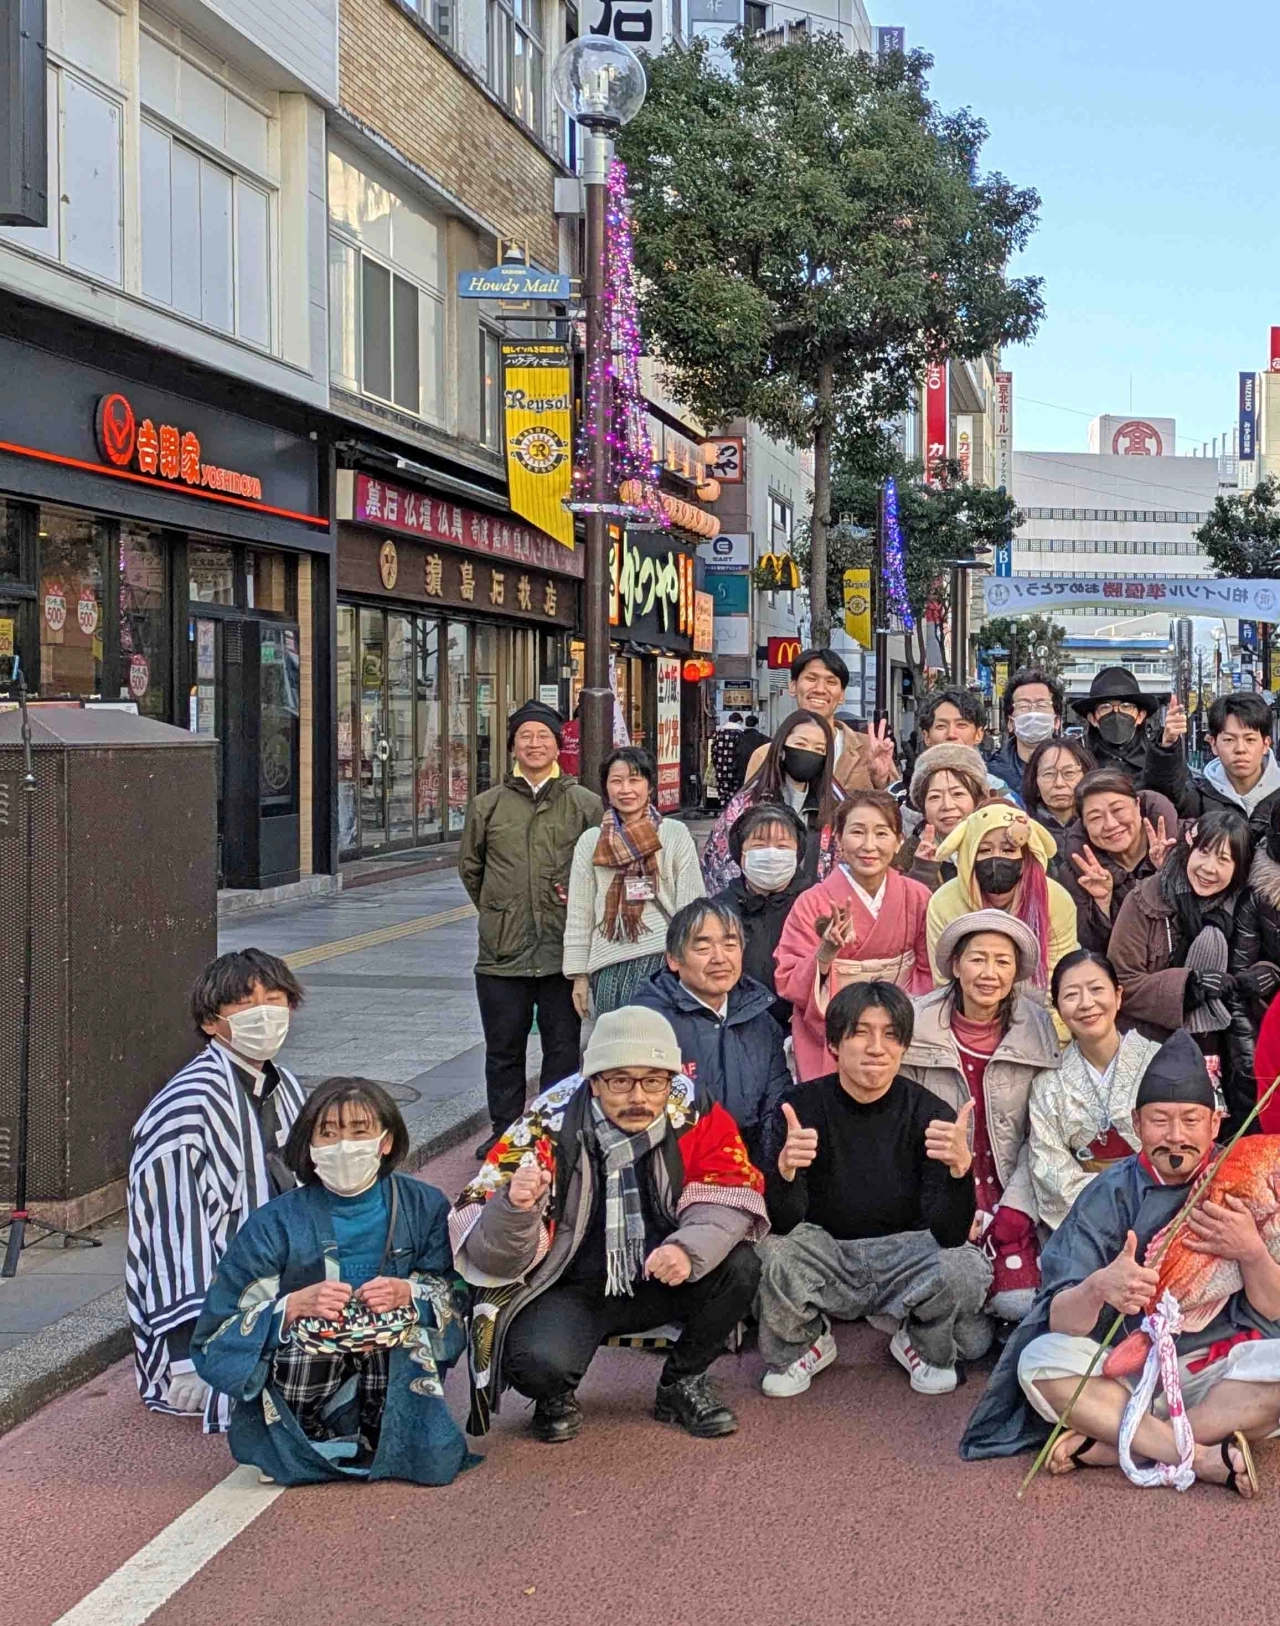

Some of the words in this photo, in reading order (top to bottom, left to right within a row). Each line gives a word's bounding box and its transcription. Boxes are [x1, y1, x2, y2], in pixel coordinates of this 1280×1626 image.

[468, 277, 520, 294] Howdy
[523, 278, 560, 293] Mall
[504, 389, 571, 414] Reysol
[998, 384, 1009, 434] 京北ホール
[1244, 378, 1253, 412] MIZUHO
[137, 418, 200, 484] 吉野家
[201, 464, 262, 499] YOSHINOYA
[366, 480, 398, 521] 墓石
[404, 493, 432, 532] 仏壇
[437, 502, 464, 542] 仏具
[619, 531, 679, 633] かつや
